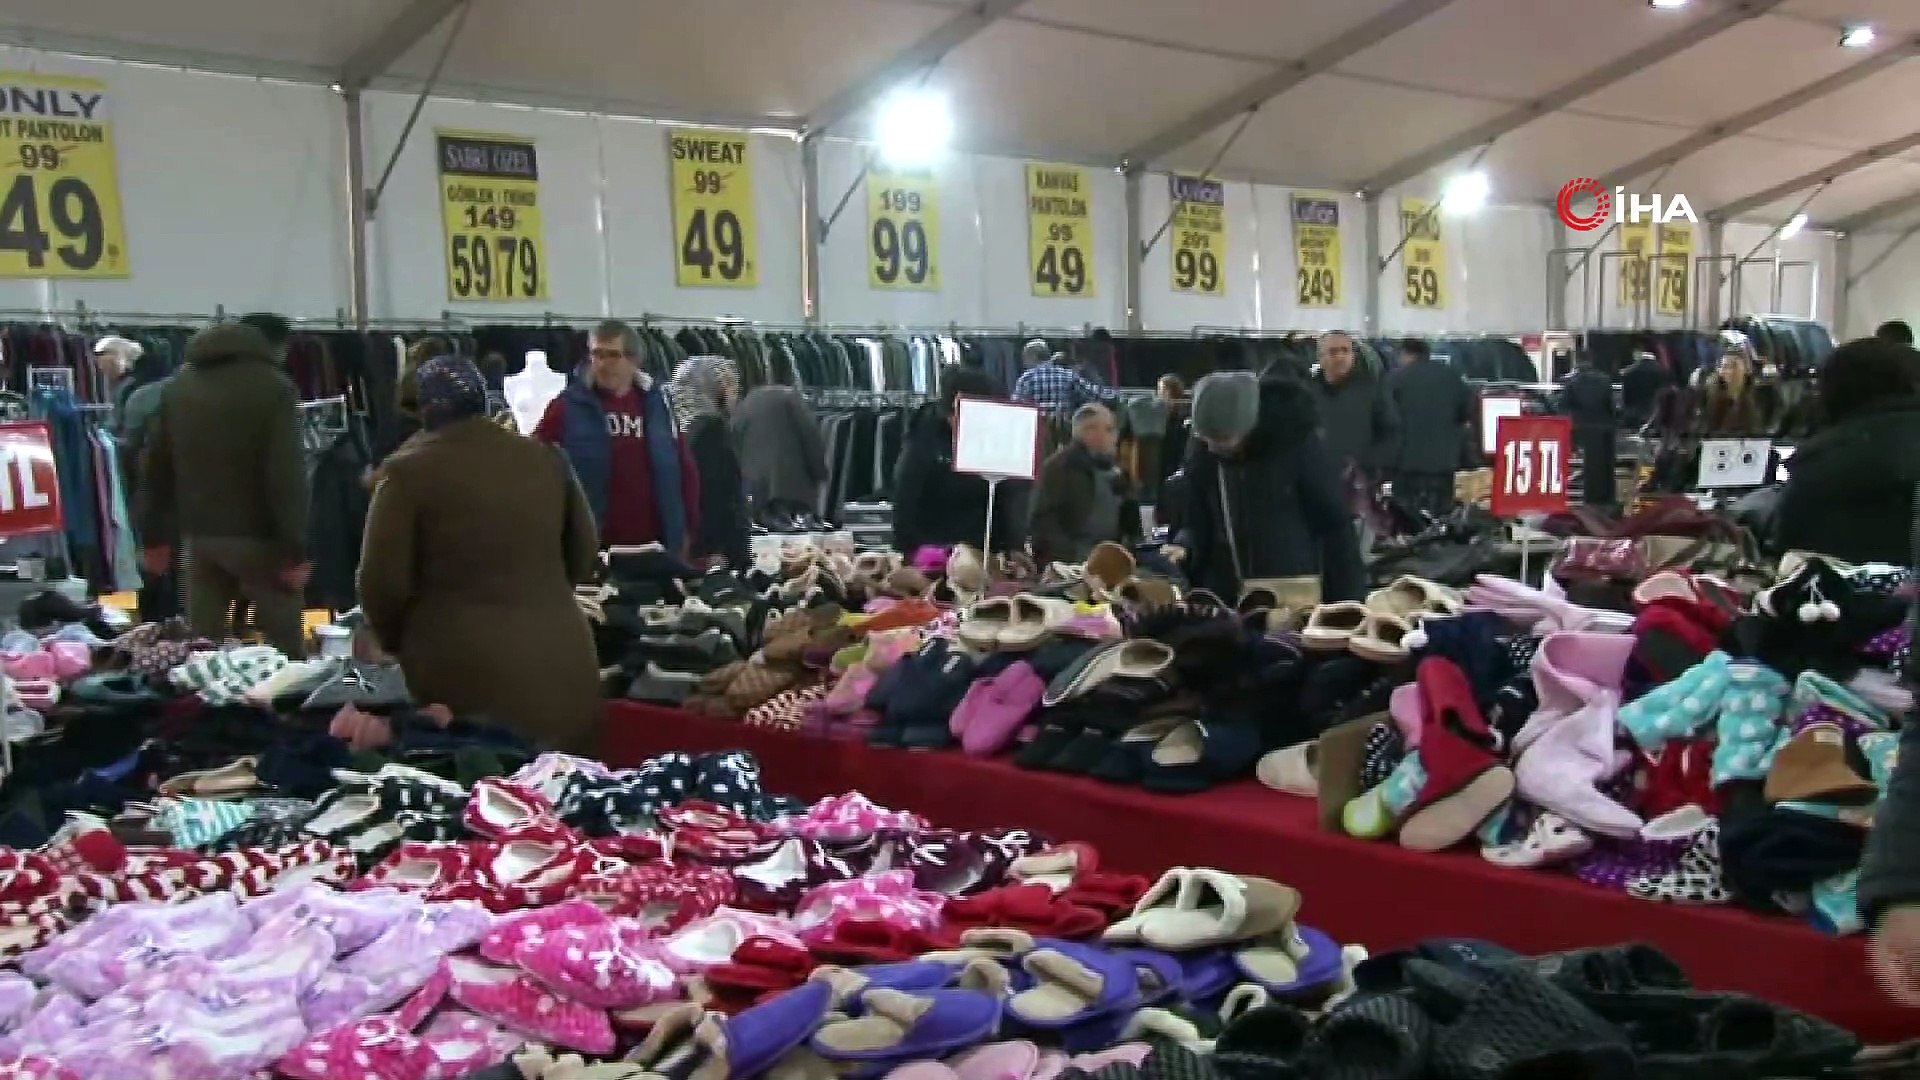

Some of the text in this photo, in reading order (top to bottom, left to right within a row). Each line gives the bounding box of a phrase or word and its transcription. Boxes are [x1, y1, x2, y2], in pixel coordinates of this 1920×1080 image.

[0, 86, 102, 119] NLY
[18, 120, 104, 142] PANTOLON
[20, 144, 59, 170] 99
[672, 137, 745, 164] SWEAT
[694, 170, 721, 194] 99
[880, 188, 921, 213] 199
[0, 175, 105, 270] 49
[465, 205, 515, 231] 149
[684, 209, 744, 280] 49
[874, 218, 928, 284] 99
[1037, 245, 1085, 293] 49
[1176, 248, 1217, 291] 99
[1298, 268, 1334, 304] 249
[1407, 266, 1438, 304] 59
[1661, 269, 1687, 309] 79
[1503, 440, 1562, 494] 15 TL
